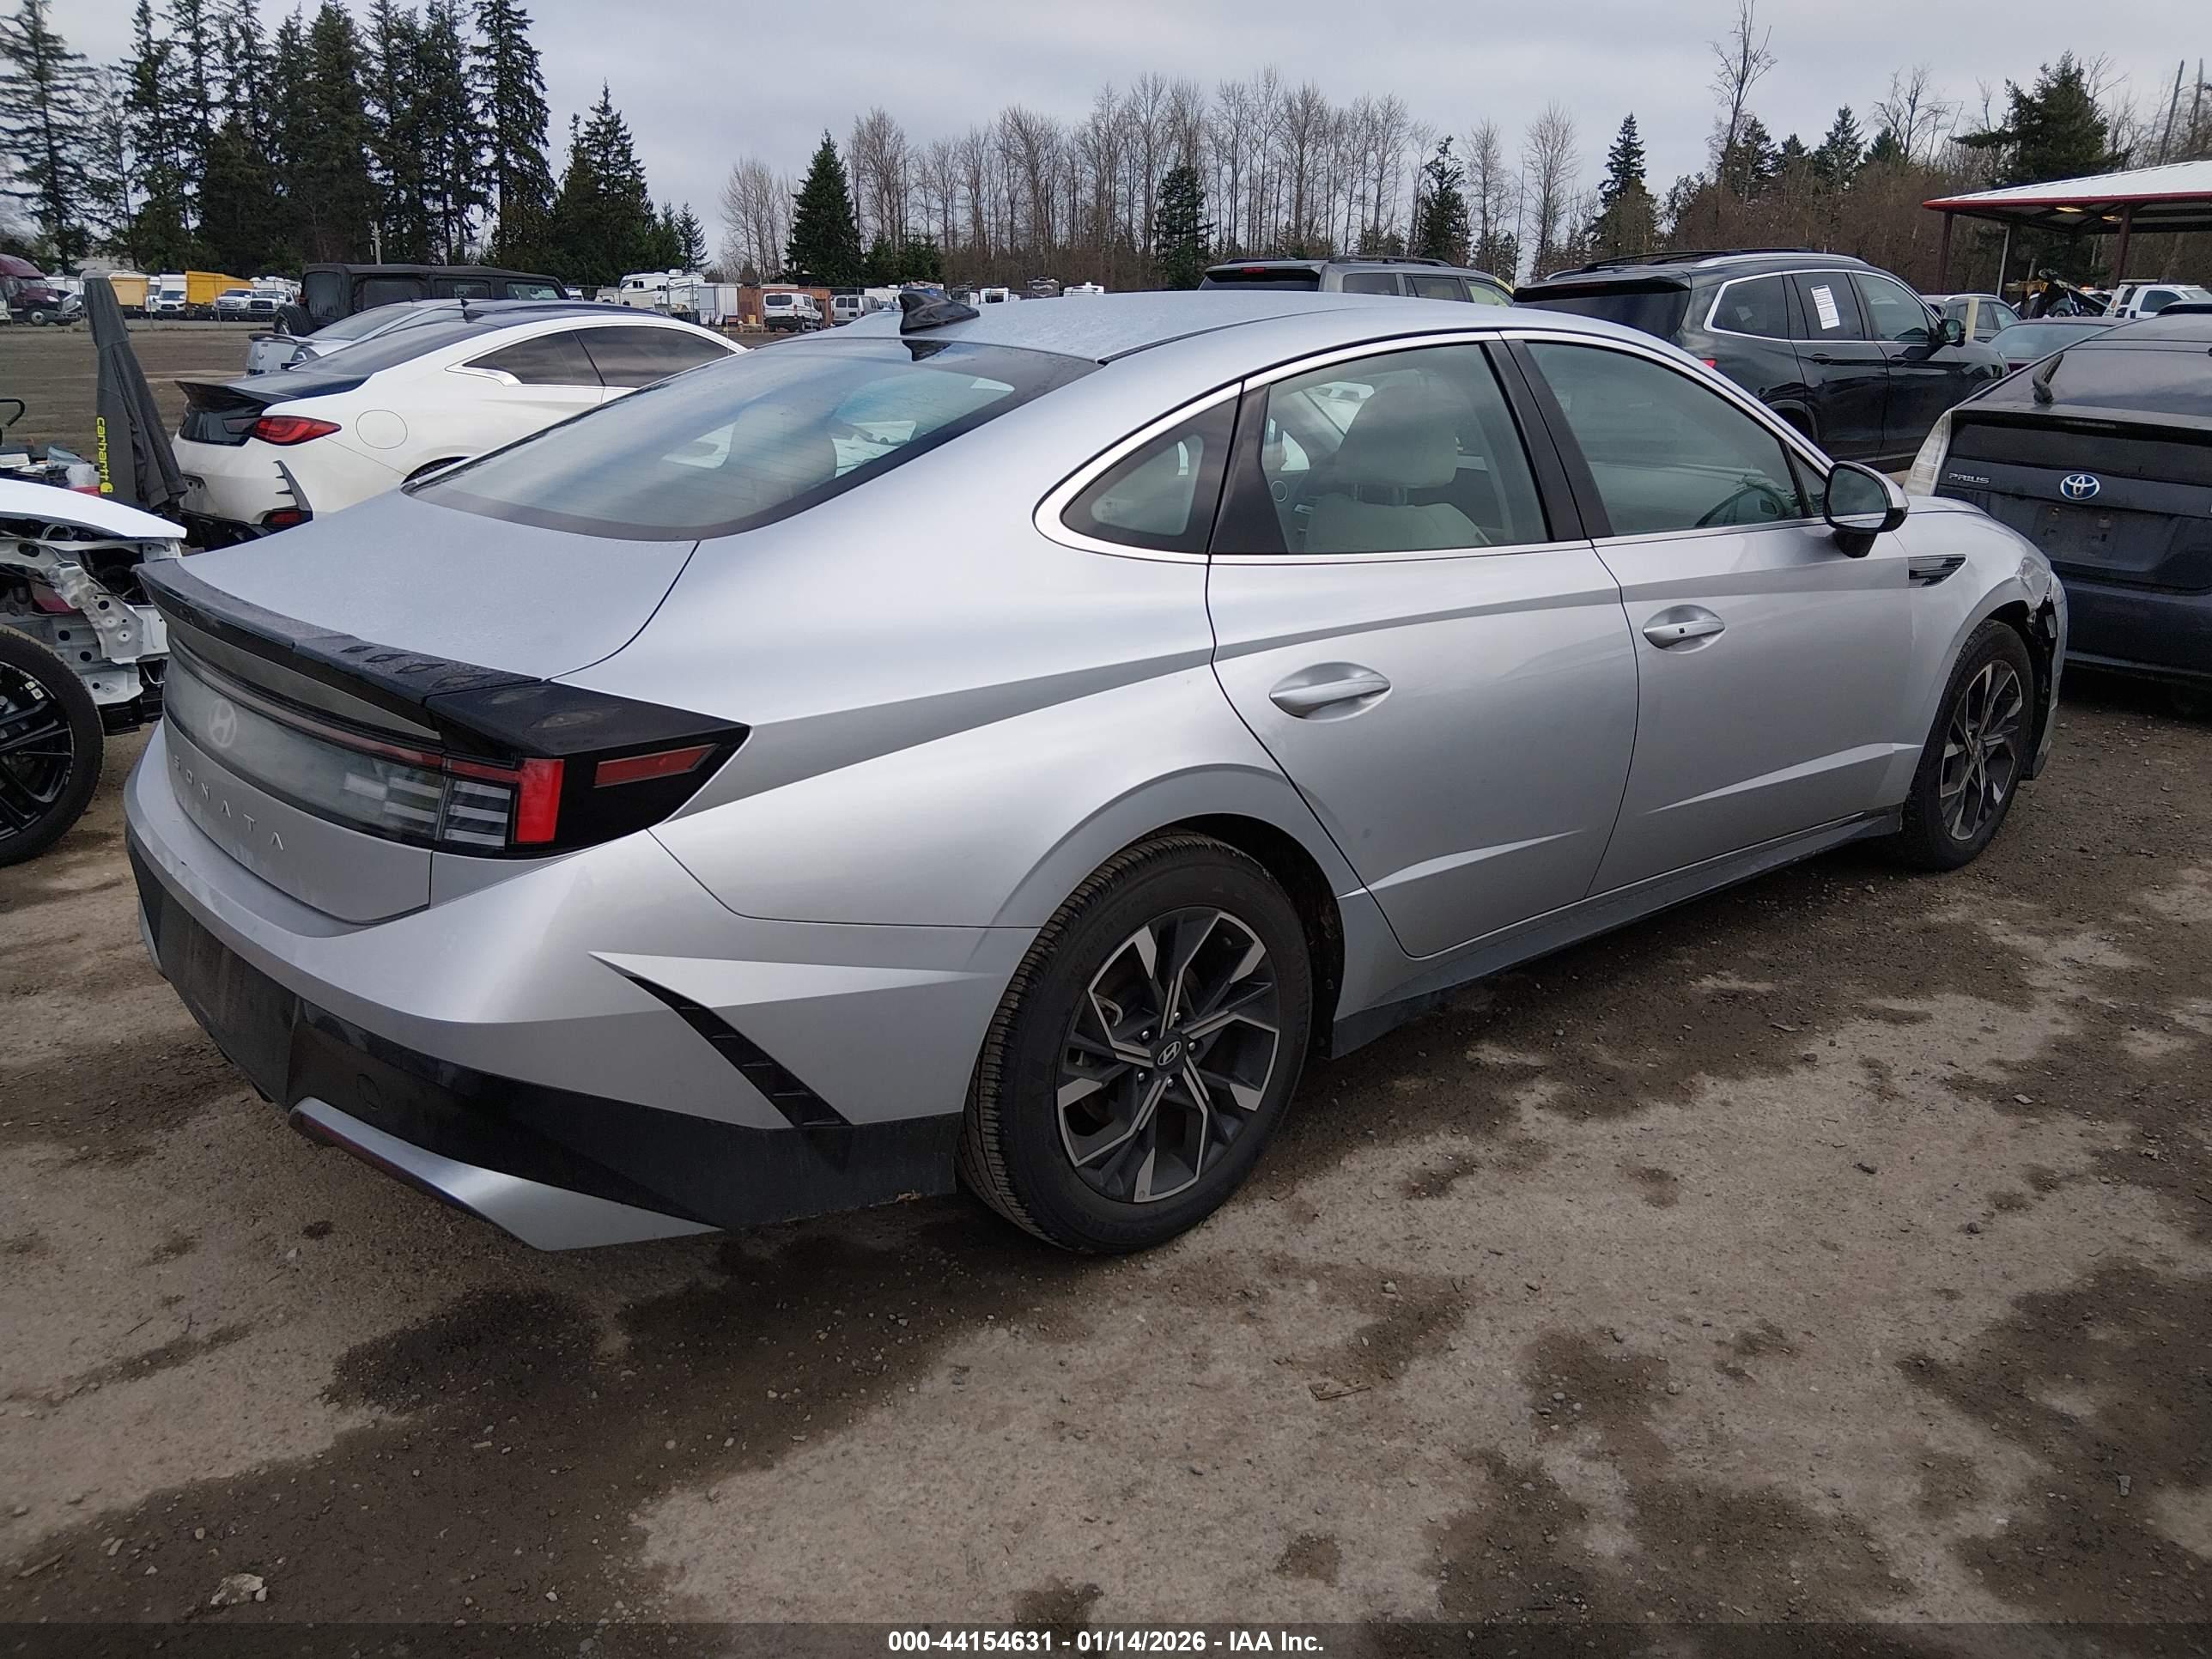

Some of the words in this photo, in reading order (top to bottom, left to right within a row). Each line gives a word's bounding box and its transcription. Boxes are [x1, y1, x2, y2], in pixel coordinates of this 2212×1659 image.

[96, 416, 111, 481] carhartt
[1948, 472, 1990, 484] PRIUS
[173, 755, 284, 851] SONATA
